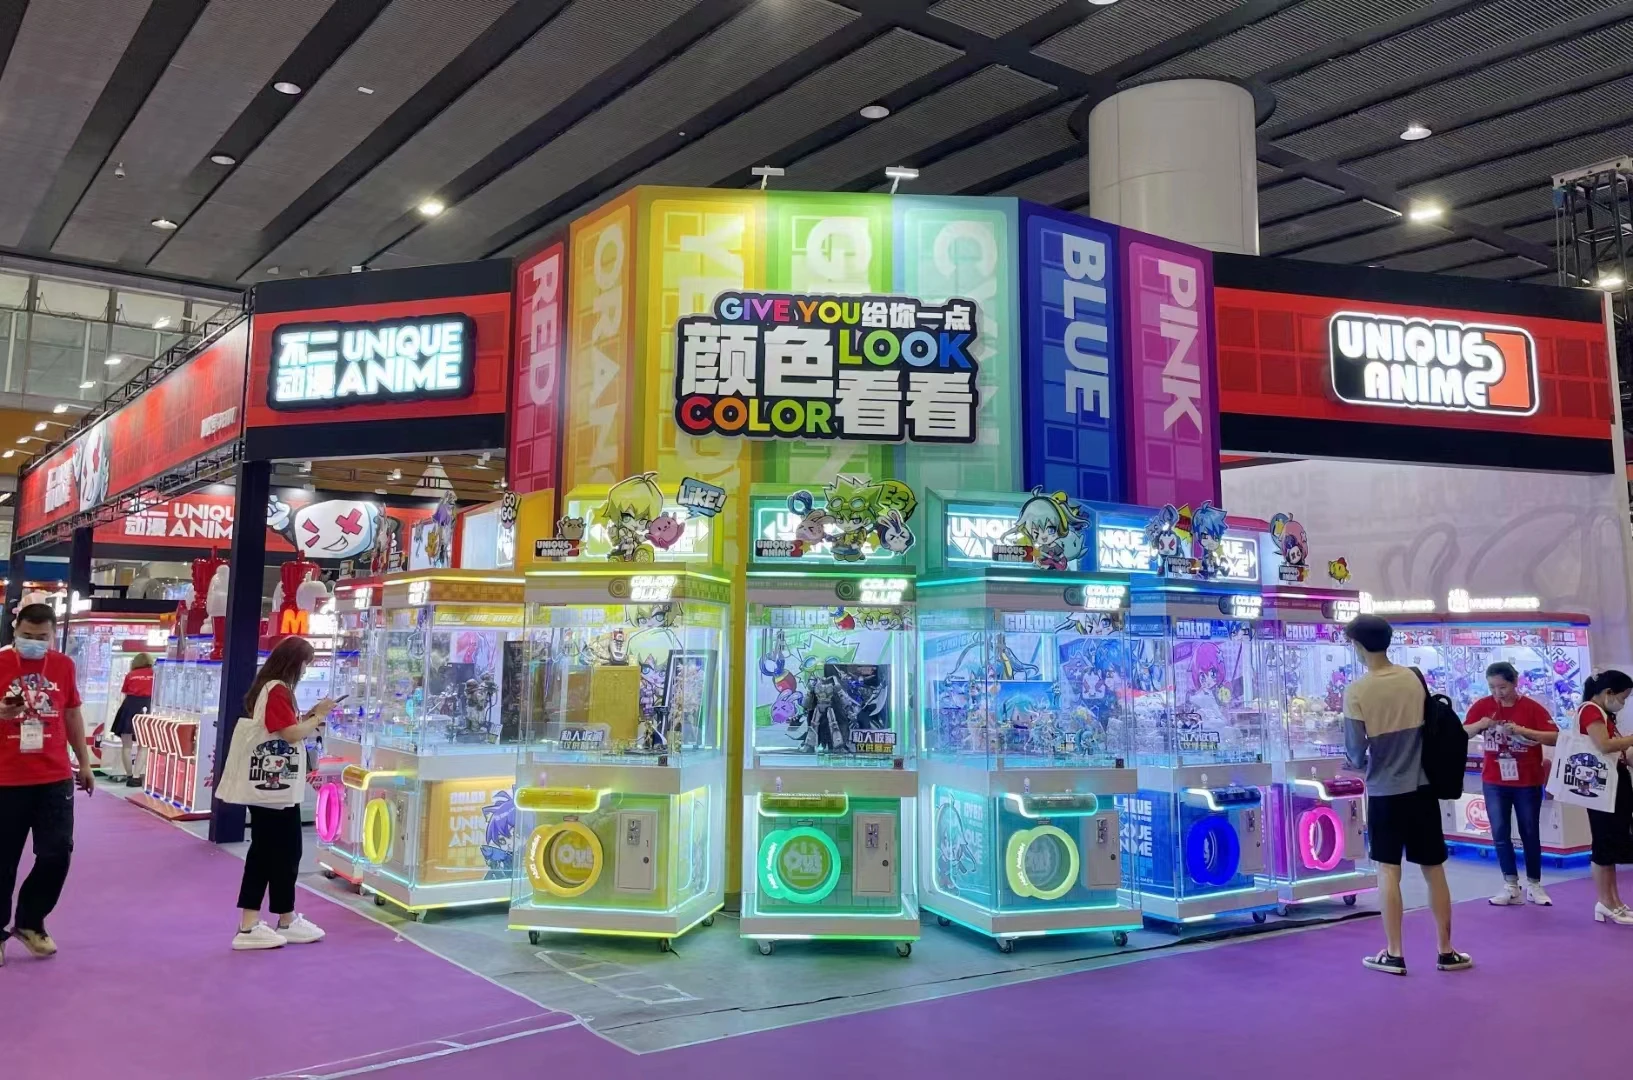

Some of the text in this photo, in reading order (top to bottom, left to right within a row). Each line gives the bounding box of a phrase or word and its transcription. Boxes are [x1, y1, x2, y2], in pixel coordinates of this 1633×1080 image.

[529, 253, 560, 405] RED
[720, 297, 861, 325] GIVE YOU
[861, 301, 971, 331] 给你一点
[1062, 232, 1110, 419] BLUE
[343, 322, 463, 361] UNIQUE
[681, 322, 834, 398] 颜色
[838, 328, 972, 368] LOOK
[1157, 259, 1203, 435] PINK
[1336, 319, 1490, 367] UNIQUE
[336, 354, 461, 396] ANIME
[1363, 361, 1488, 406] ANIME
[681, 396, 832, 434] COLOR
[835, 370, 973, 438] 看看
[169, 520, 233, 539] ANIM
[174, 503, 234, 521] UNIQU
[852, 731, 896, 744] 私人收藏
